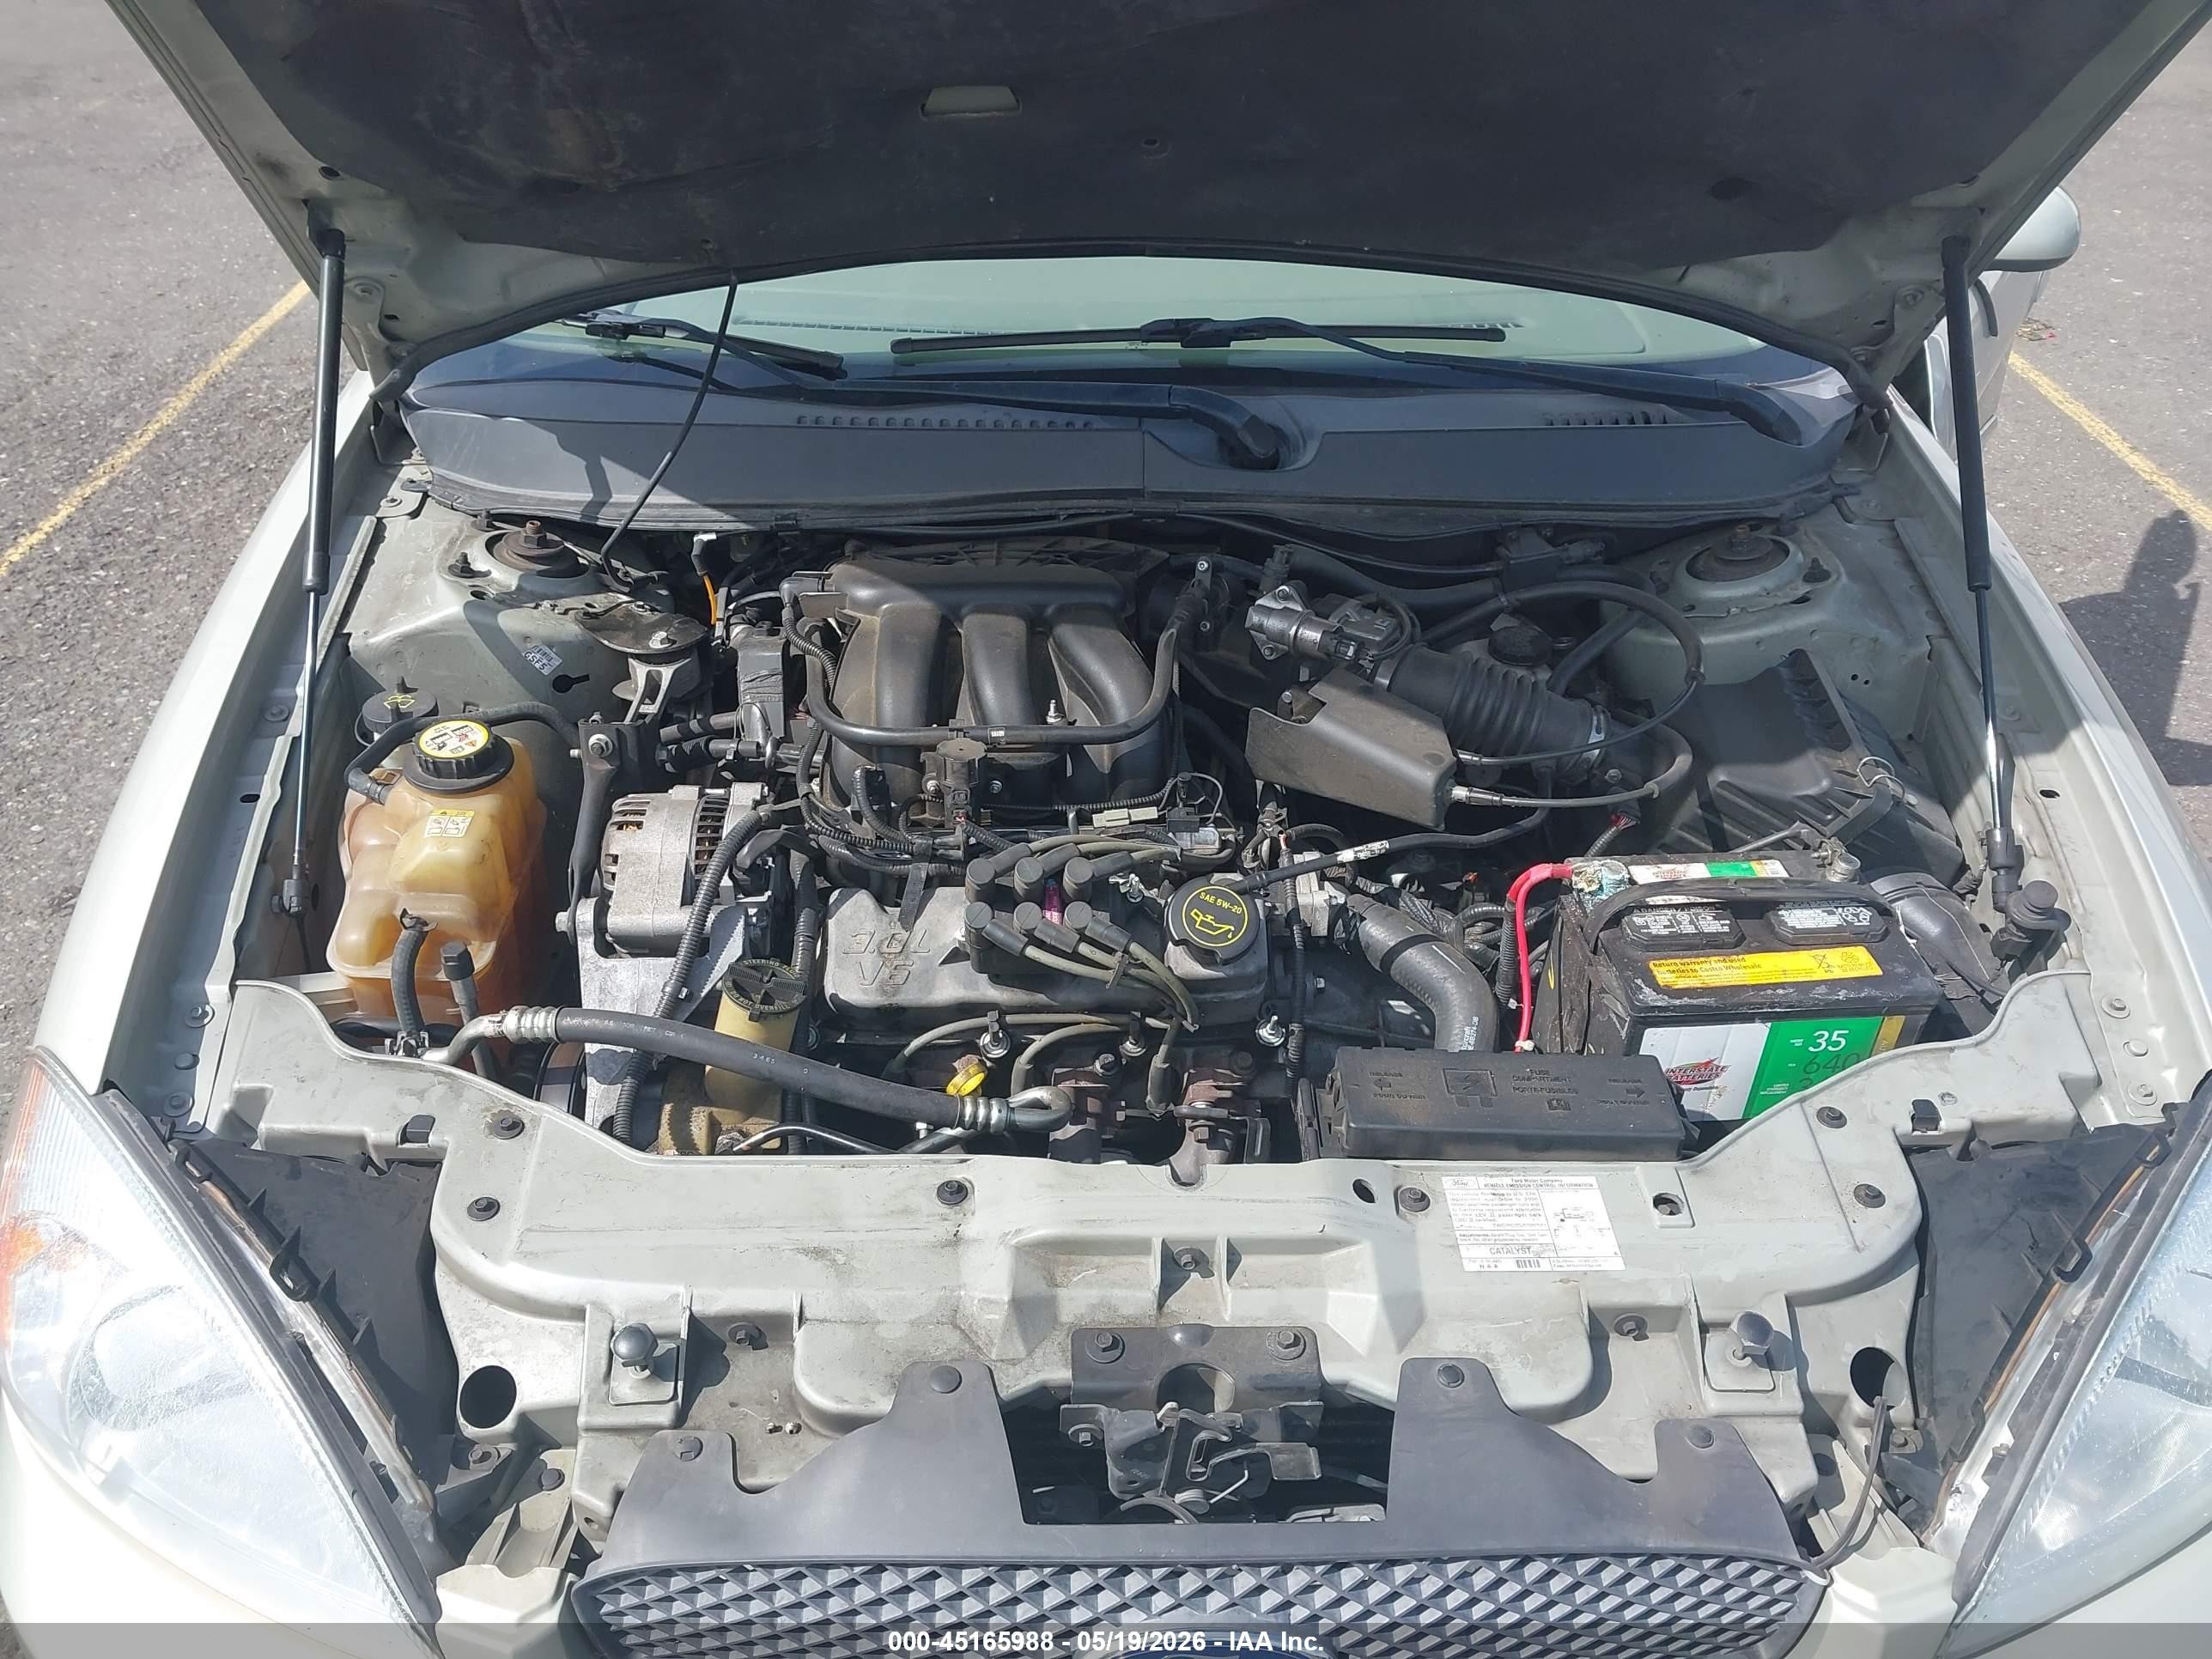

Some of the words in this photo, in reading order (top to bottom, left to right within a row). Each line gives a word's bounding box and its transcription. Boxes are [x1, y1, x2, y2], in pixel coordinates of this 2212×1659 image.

[1199, 892, 1217, 904] SAE
[1216, 898, 1243, 915] 5W-20
[842, 927, 931, 955] 3.0L
[743, 958, 780, 967] STEERING
[859, 961, 915, 987] V6
[738, 996, 753, 1006] NOT
[1808, 1030, 1849, 1052] 35
[1666, 1065, 1729, 1074] INTERSTATE
[1489, 1247, 1532, 1255] CATALYST
